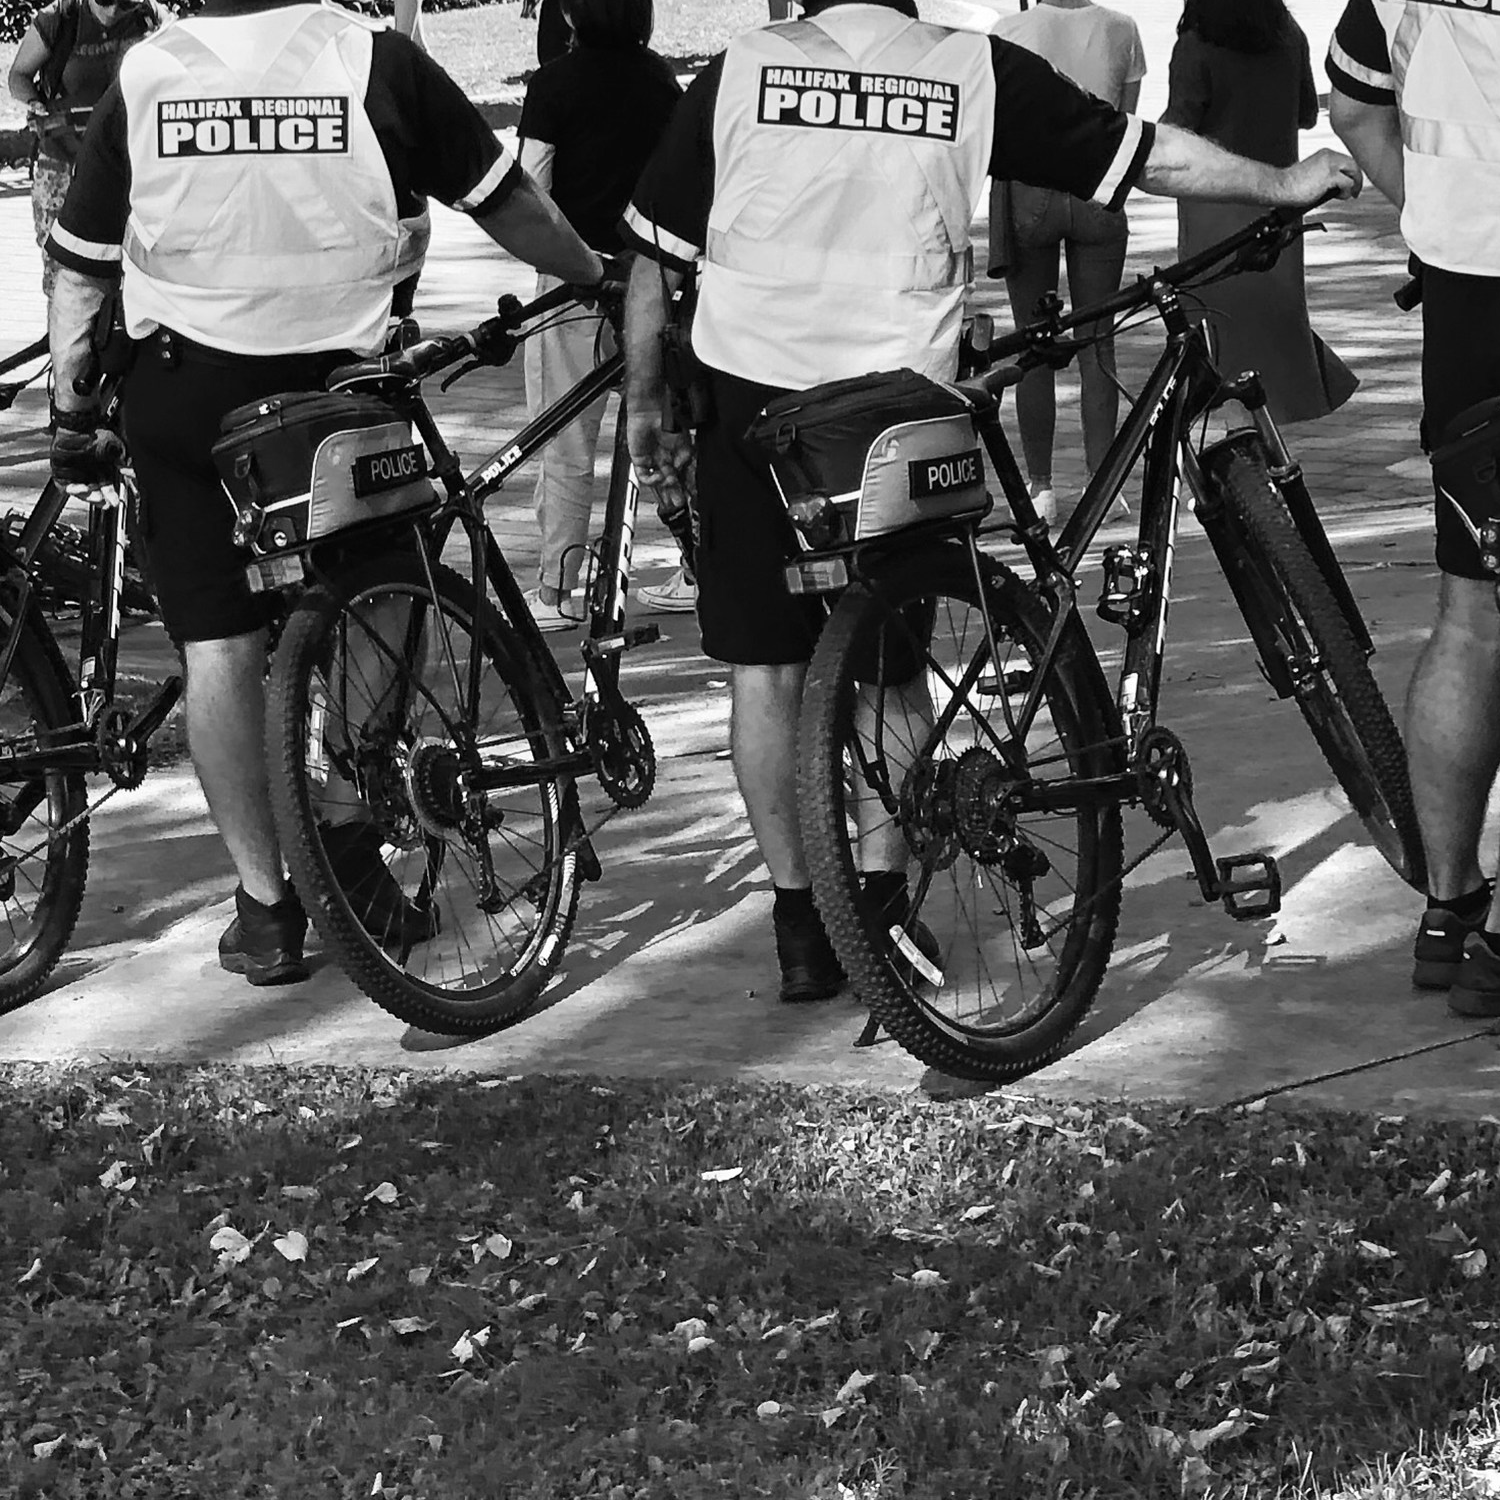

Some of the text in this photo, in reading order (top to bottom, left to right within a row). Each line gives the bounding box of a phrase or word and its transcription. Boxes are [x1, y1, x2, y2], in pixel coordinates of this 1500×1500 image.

[765, 69, 954, 102] HALIFAX REGIONAL
[161, 99, 344, 120] HALIFAX REGIONAL
[763, 87, 954, 137] POLICE
[161, 117, 344, 155] POLICE
[371, 451, 419, 482] POLICE
[480, 444, 523, 484] POLICE
[928, 457, 977, 490] POLICE
